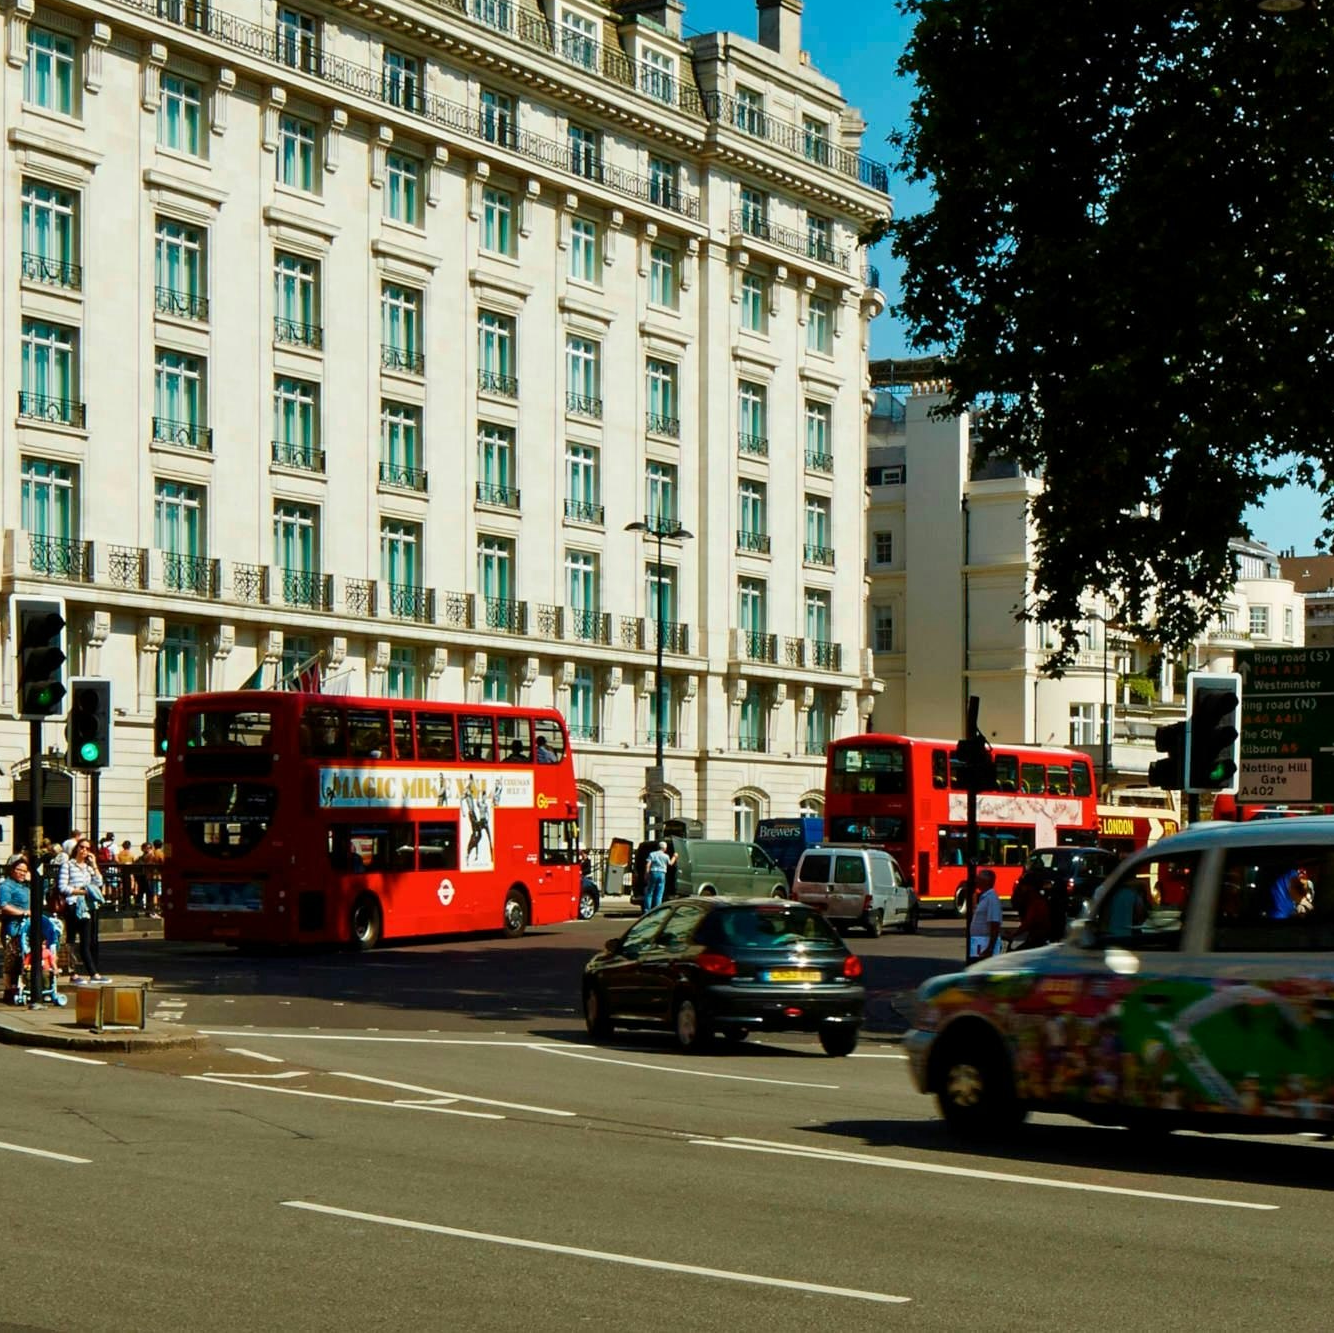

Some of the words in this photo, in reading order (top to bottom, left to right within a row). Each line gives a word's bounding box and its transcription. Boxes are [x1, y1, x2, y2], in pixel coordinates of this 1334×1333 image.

[1253, 653, 1278, 665] Ring
[1281, 652, 1307, 663] road
[1309, 650, 1331, 663] (S)
[1253, 679, 1322, 691] Westminster
[1266, 699, 1292, 710] road
[1294, 697, 1317, 710] (N)
[1259, 728, 1284, 741] City
[1241, 761, 1284, 775] Notting
[1288, 762, 1309, 773] Hill
[1260, 775, 1288, 785] Gate
[333, 775, 397, 799] MAGIC
[401, 776, 452, 799] MIKE
[1241, 785, 1275, 796] A402
[759, 825, 802, 838] Brewers
[1103, 818, 1134, 836] LONDON
